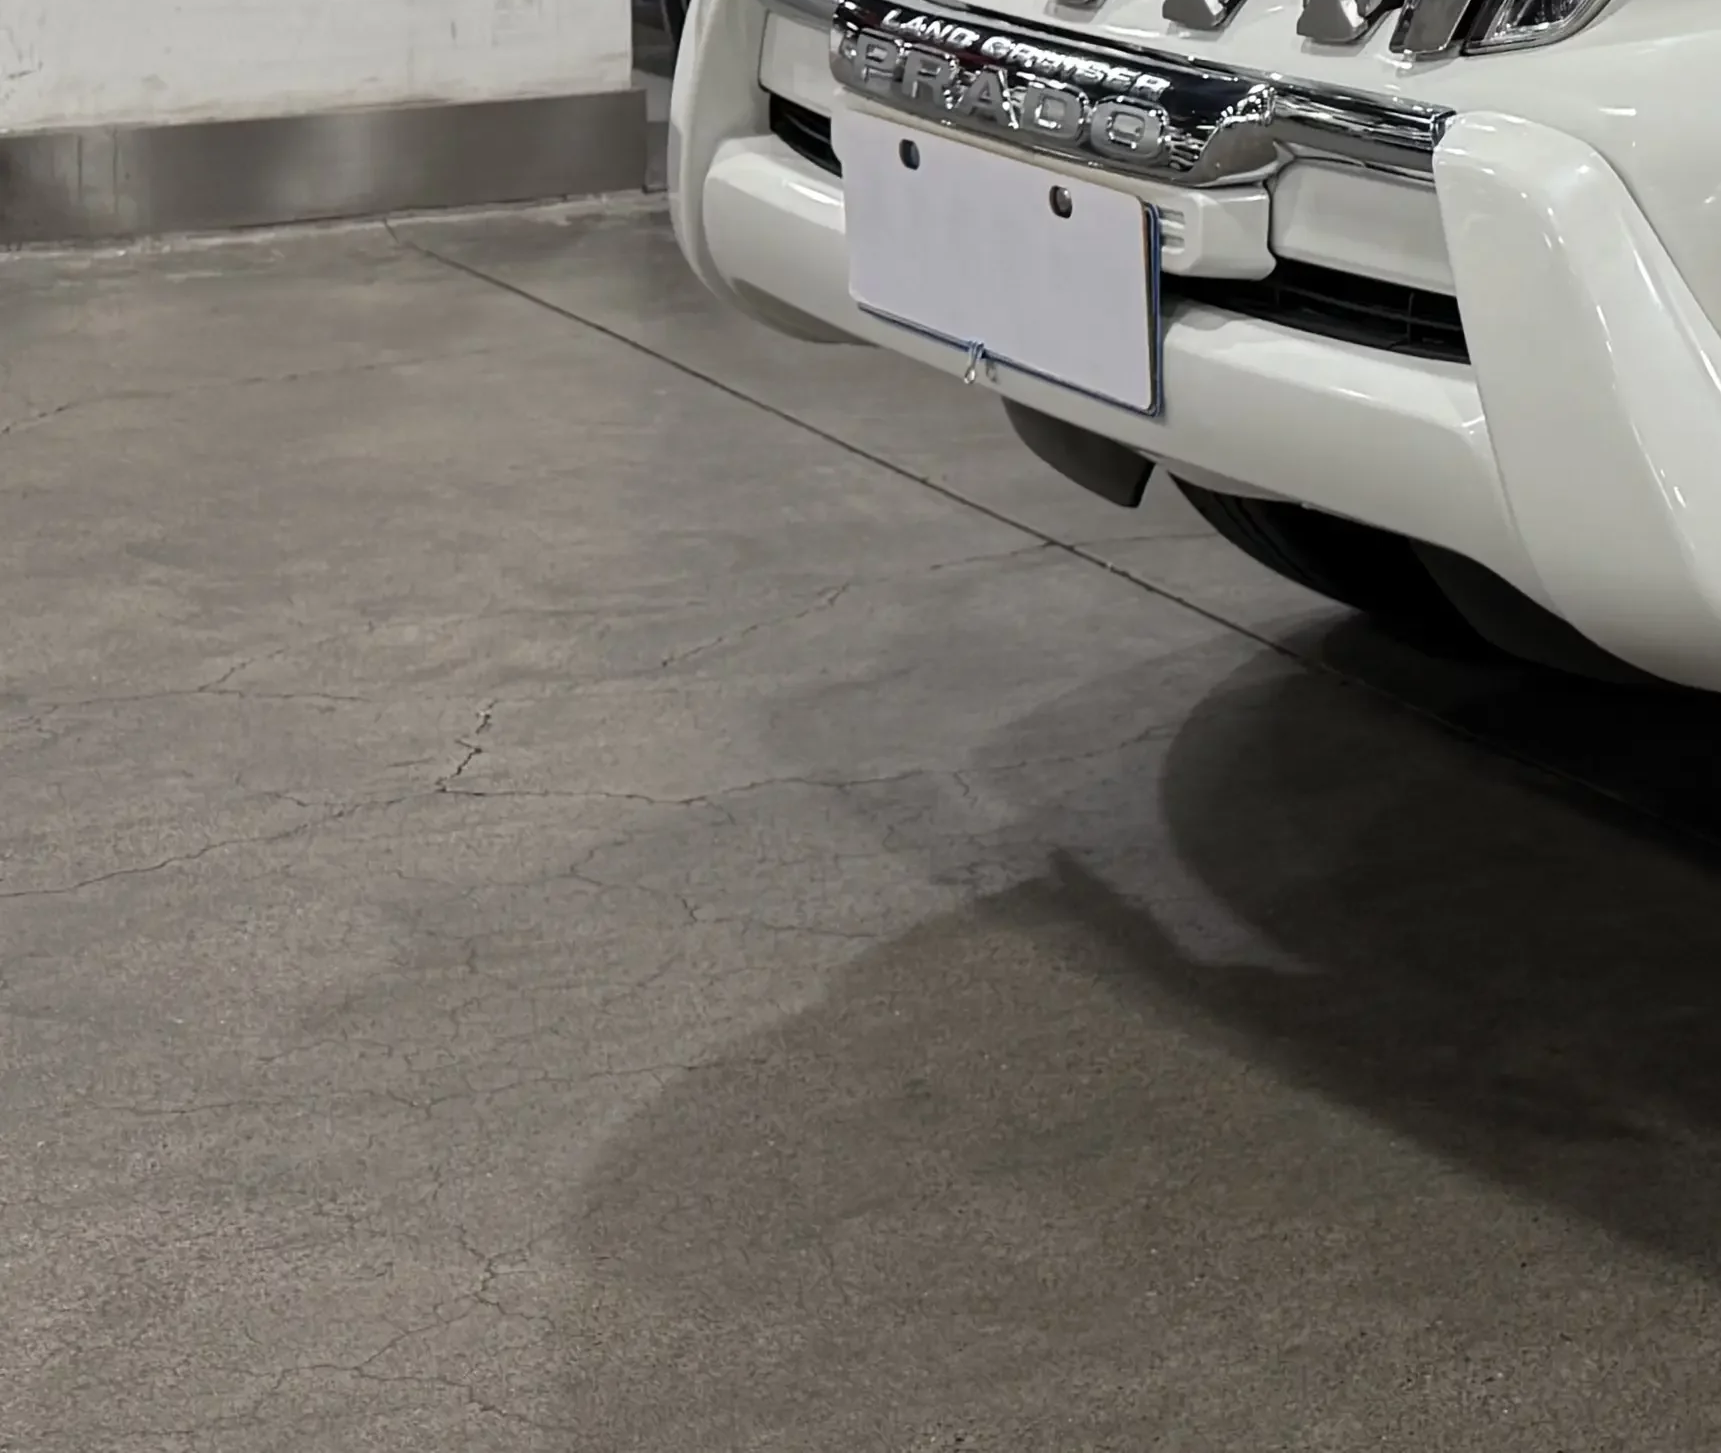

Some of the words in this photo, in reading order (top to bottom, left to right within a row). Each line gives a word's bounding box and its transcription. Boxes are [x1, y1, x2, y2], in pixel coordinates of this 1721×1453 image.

[845, 27, 1172, 166] PRADO
[881, 8, 981, 48] LAND
[981, 35, 1172, 100] CRUISER
